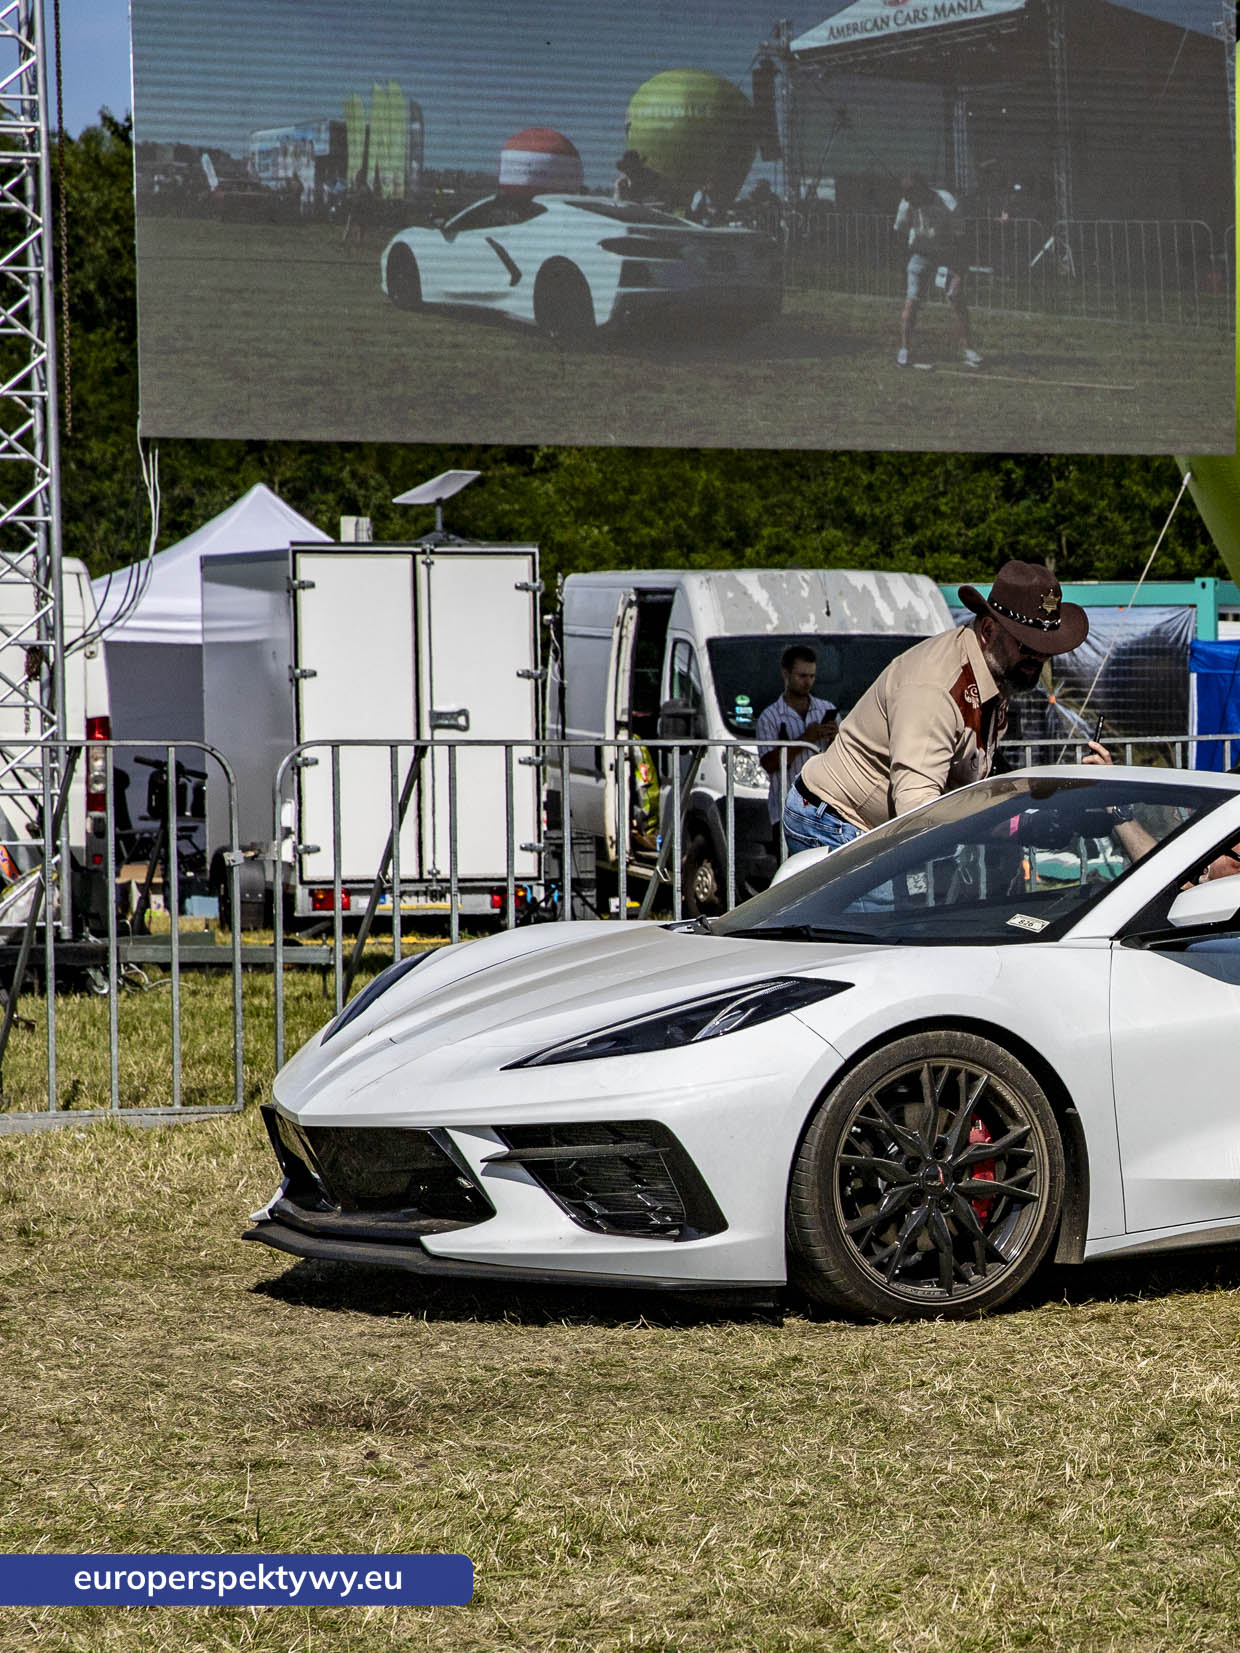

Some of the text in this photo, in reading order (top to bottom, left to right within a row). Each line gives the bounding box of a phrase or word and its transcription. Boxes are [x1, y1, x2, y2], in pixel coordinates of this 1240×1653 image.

[827, 0, 984, 41] AMERICAN CARS MANIA
